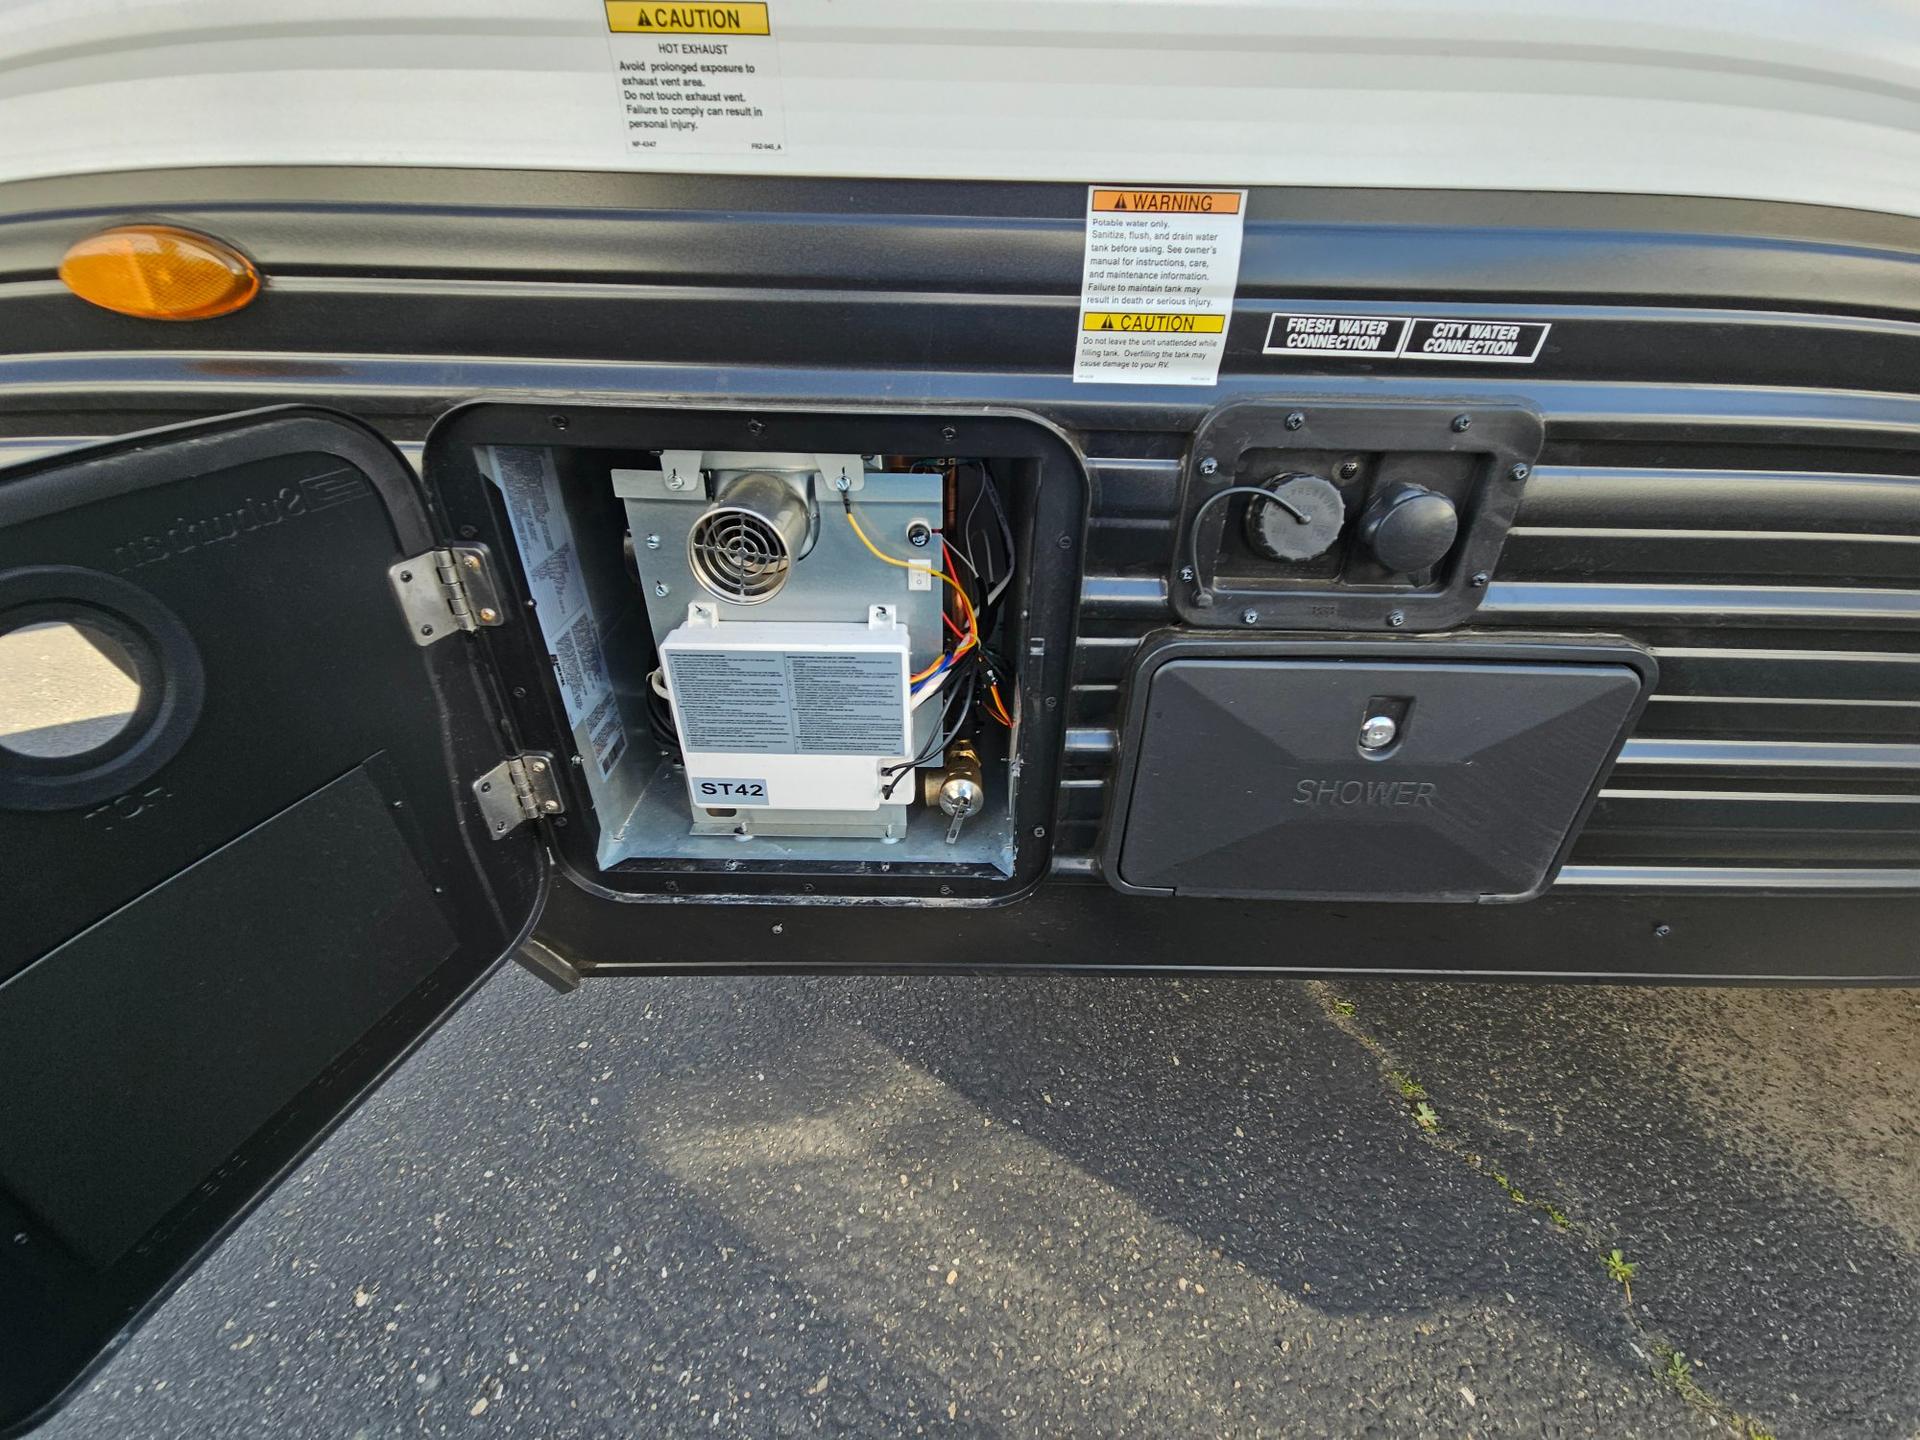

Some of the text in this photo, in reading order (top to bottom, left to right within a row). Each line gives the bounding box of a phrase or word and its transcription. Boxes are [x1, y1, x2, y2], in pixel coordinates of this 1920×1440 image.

[655, 9, 741, 28] CAUTION
[658, 43, 728, 55] HOT EXHAUST
[619, 61, 755, 75] Avoid prolonged exposure to
[622, 76, 705, 87] exhaust vent area.
[624, 91, 746, 102] Do not touch exhaust vent.
[627, 105, 763, 118] Failure to comply can result in
[629, 119, 698, 132] personal injury.
[1133, 194, 1213, 212] WARNING
[1092, 218, 1170, 230] Potable water only.
[1091, 230, 1218, 242] Sanitize, flush, and drain water
[1091, 243, 1217, 255] tank before using. See owner's
[1090, 257, 1209, 268] manual for instructions, care,
[1089, 270, 1209, 281] and maintenance information.
[1088, 283, 1201, 295] Failure to maintain tank may
[1087, 296, 1213, 308] result in death or serious injury.
[1120, 314, 1195, 332] CAUTION
[1286, 318, 1389, 336] FRESH WATER
[1432, 323, 1521, 341] CITY WATER
[1083, 337, 1093, 345] Do
[1095, 337, 1107, 345] not
[1108, 337, 1126, 345] leave
[1128, 338, 1140, 346] the
[1142, 338, 1156, 346] unit
[1198, 339, 1218, 347] while
[1286, 334, 1381, 350] CONNECTION
[1422, 339, 1518, 356] CONNECTION
[1081, 349, 1101, 357] filling
[1103, 349, 1119, 357] tank.
[1123, 350, 1160, 359] Overfilling
[1162, 350, 1173, 358] the
[1191, 352, 1207, 360] may
[1102, 361, 1130, 370] damage
[1140, 362, 1156, 370] your
[1158, 361, 1170, 369] RV.
[701, 782, 764, 797] ST42
[1293, 779, 1438, 808] SHOWER
